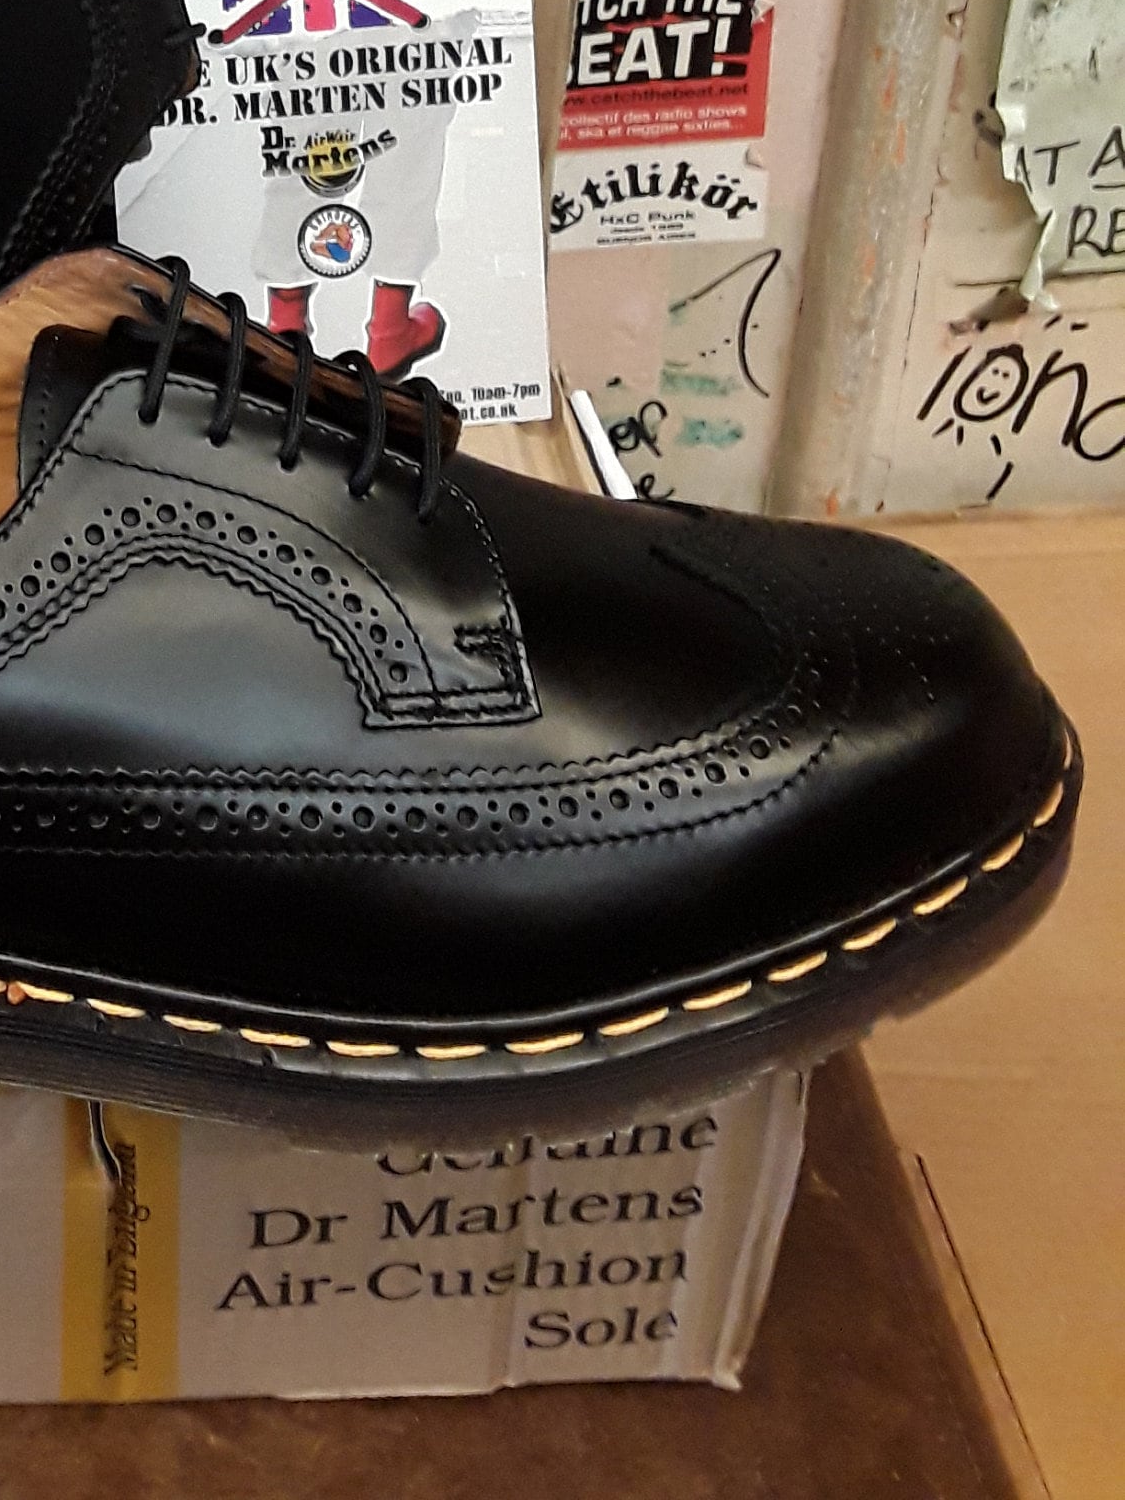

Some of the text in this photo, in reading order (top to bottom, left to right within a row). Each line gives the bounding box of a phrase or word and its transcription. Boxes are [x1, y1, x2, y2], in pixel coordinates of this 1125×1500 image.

[225, 50, 316, 86] UK'S
[329, 37, 512, 78] ORIGINAL
[565, 17, 731, 86] EAT!
[233, 82, 387, 122] MARTEN
[401, 73, 502, 109] SHOP
[262, 129, 398, 177] Martens
[648, 209, 694, 222] Punk
[471, 383, 541, 402] 10am-7pm
[248, 1182, 703, 1252] Dr Martens
[217, 1247, 688, 1312] Air-Cushion
[524, 1307, 678, 1351] Sole
